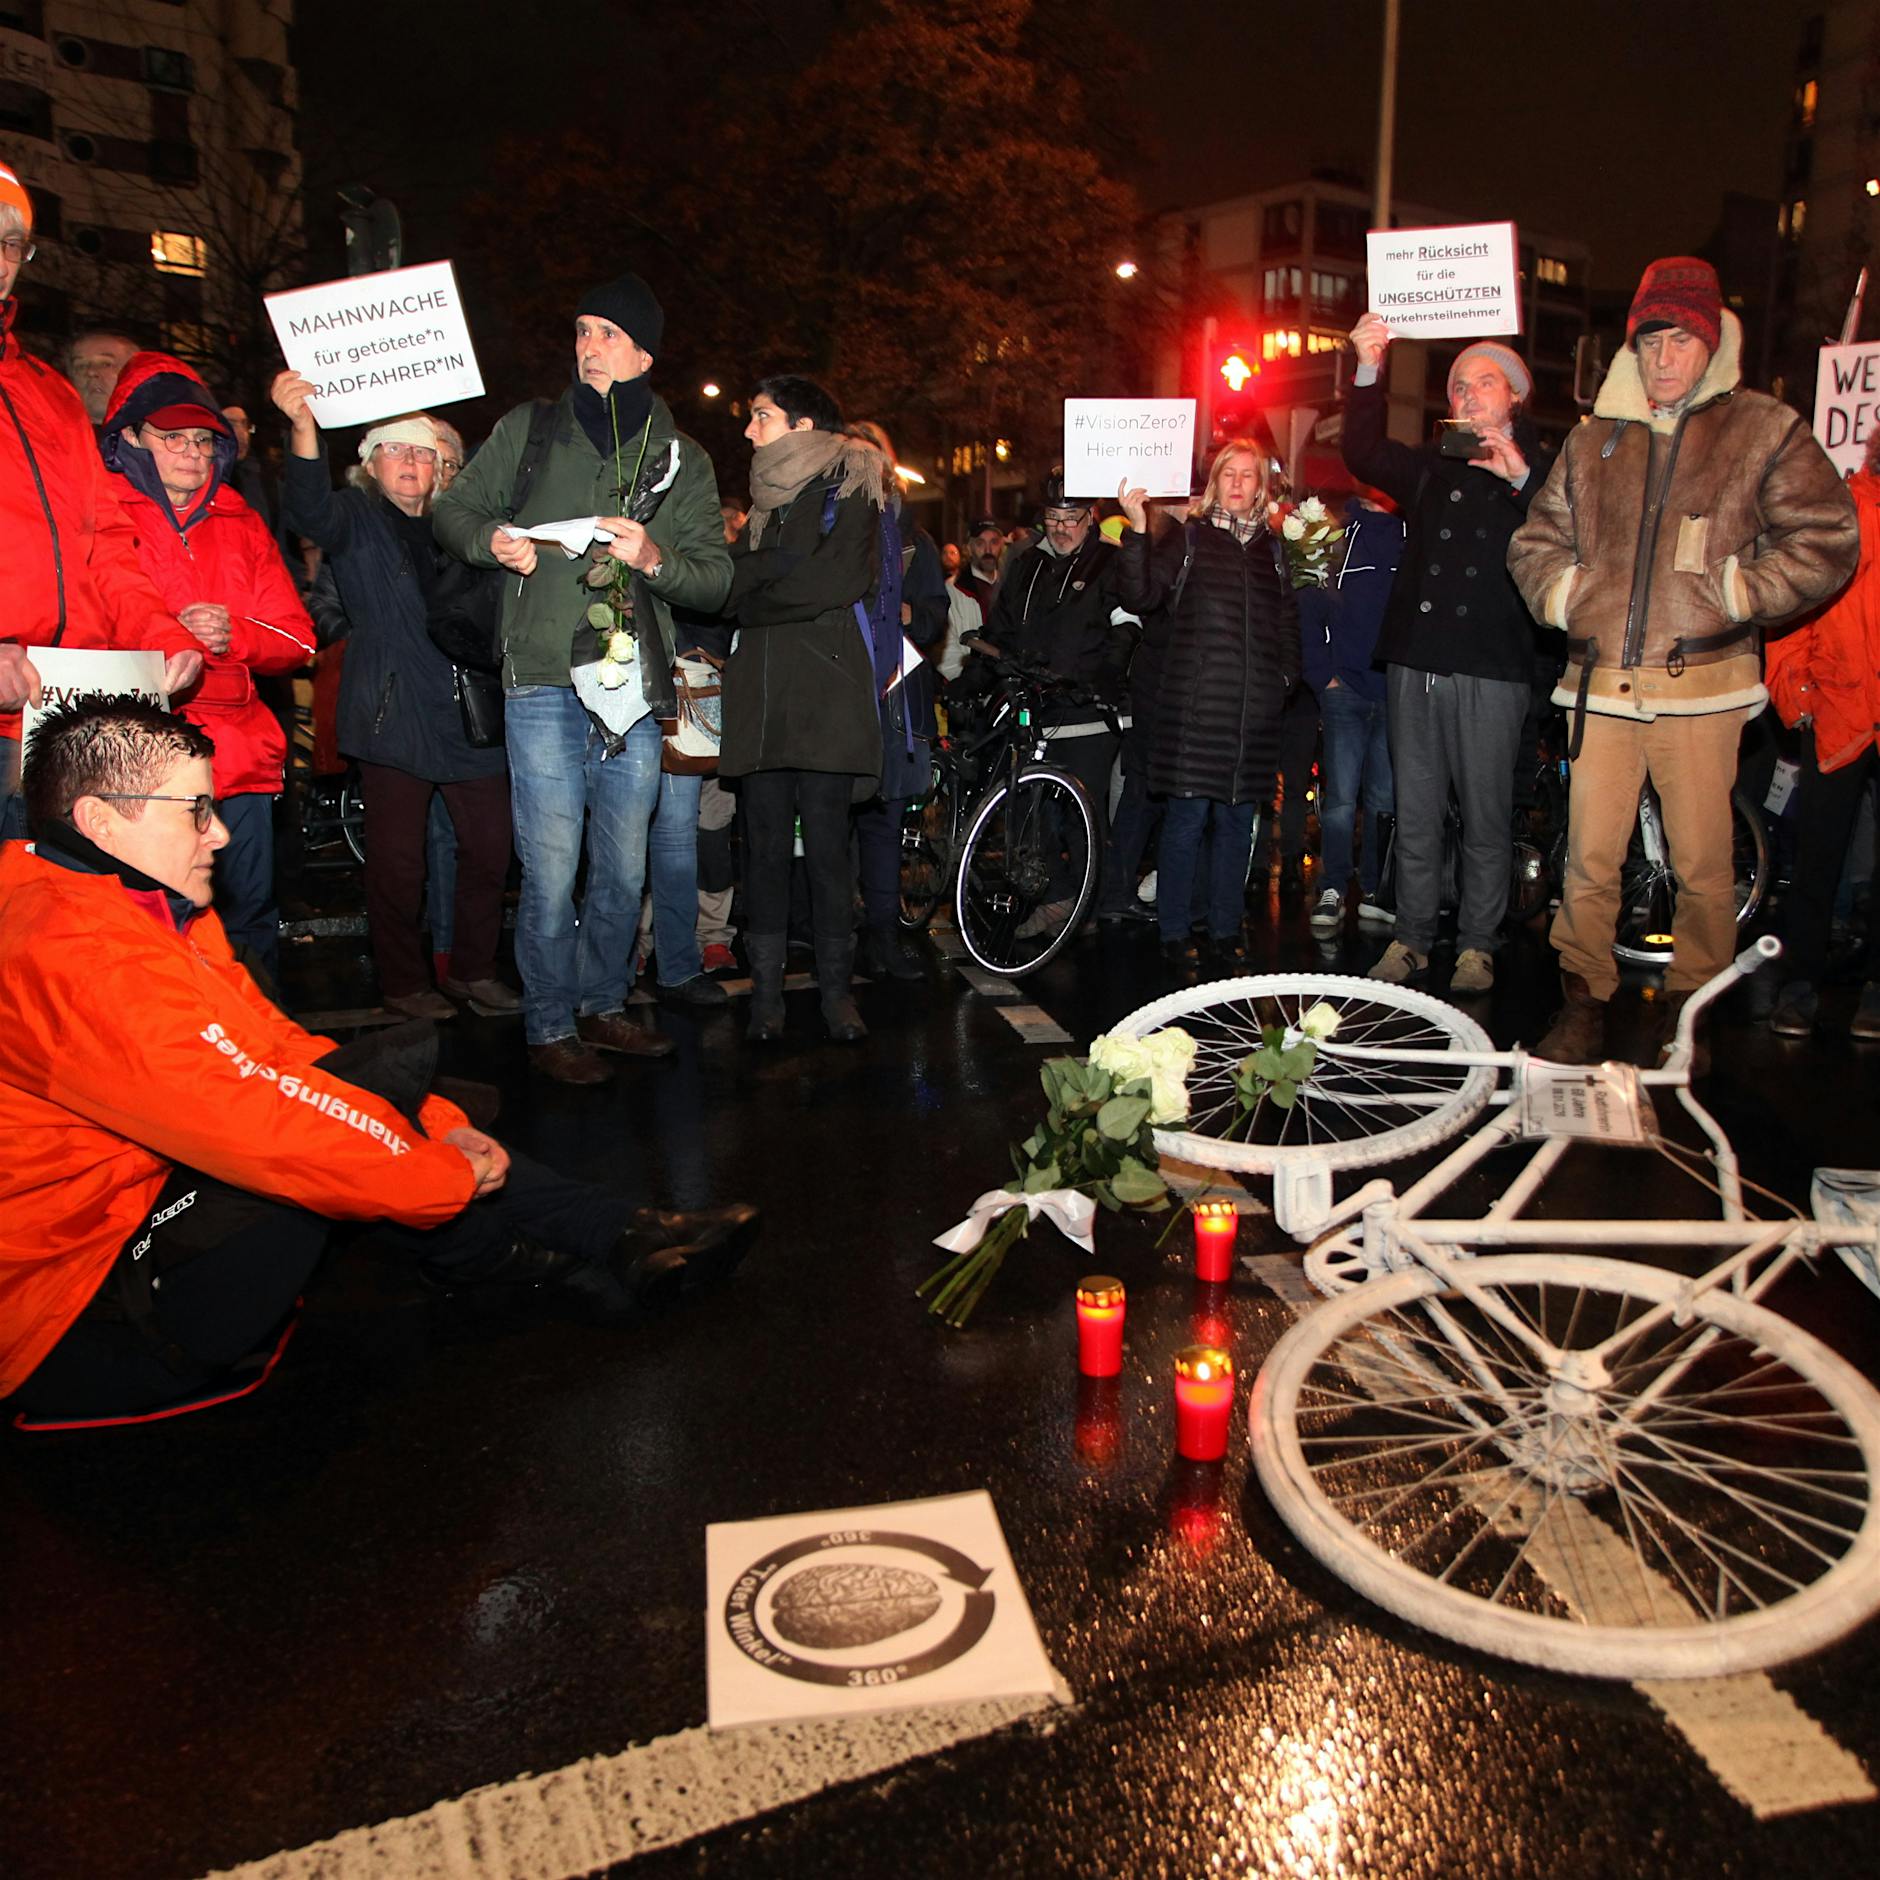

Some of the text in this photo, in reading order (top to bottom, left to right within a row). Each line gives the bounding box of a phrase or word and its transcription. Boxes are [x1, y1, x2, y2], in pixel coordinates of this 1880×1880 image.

[1386, 242, 1489, 261] mehr Rücksicht
[1416, 268, 1456, 281] für die
[1378, 285, 1502, 305] UNGESCHÜTZTEN
[288, 289, 448, 337] MAHNWACHE
[1381, 307, 1501, 324] Verkehrsteilnehmer
[313, 349, 341, 367] für
[1074, 413, 1187, 430] #VisionZero?
[1087, 441, 1174, 457] Hier nicht!
[848, 1664, 908, 1687] 360°
